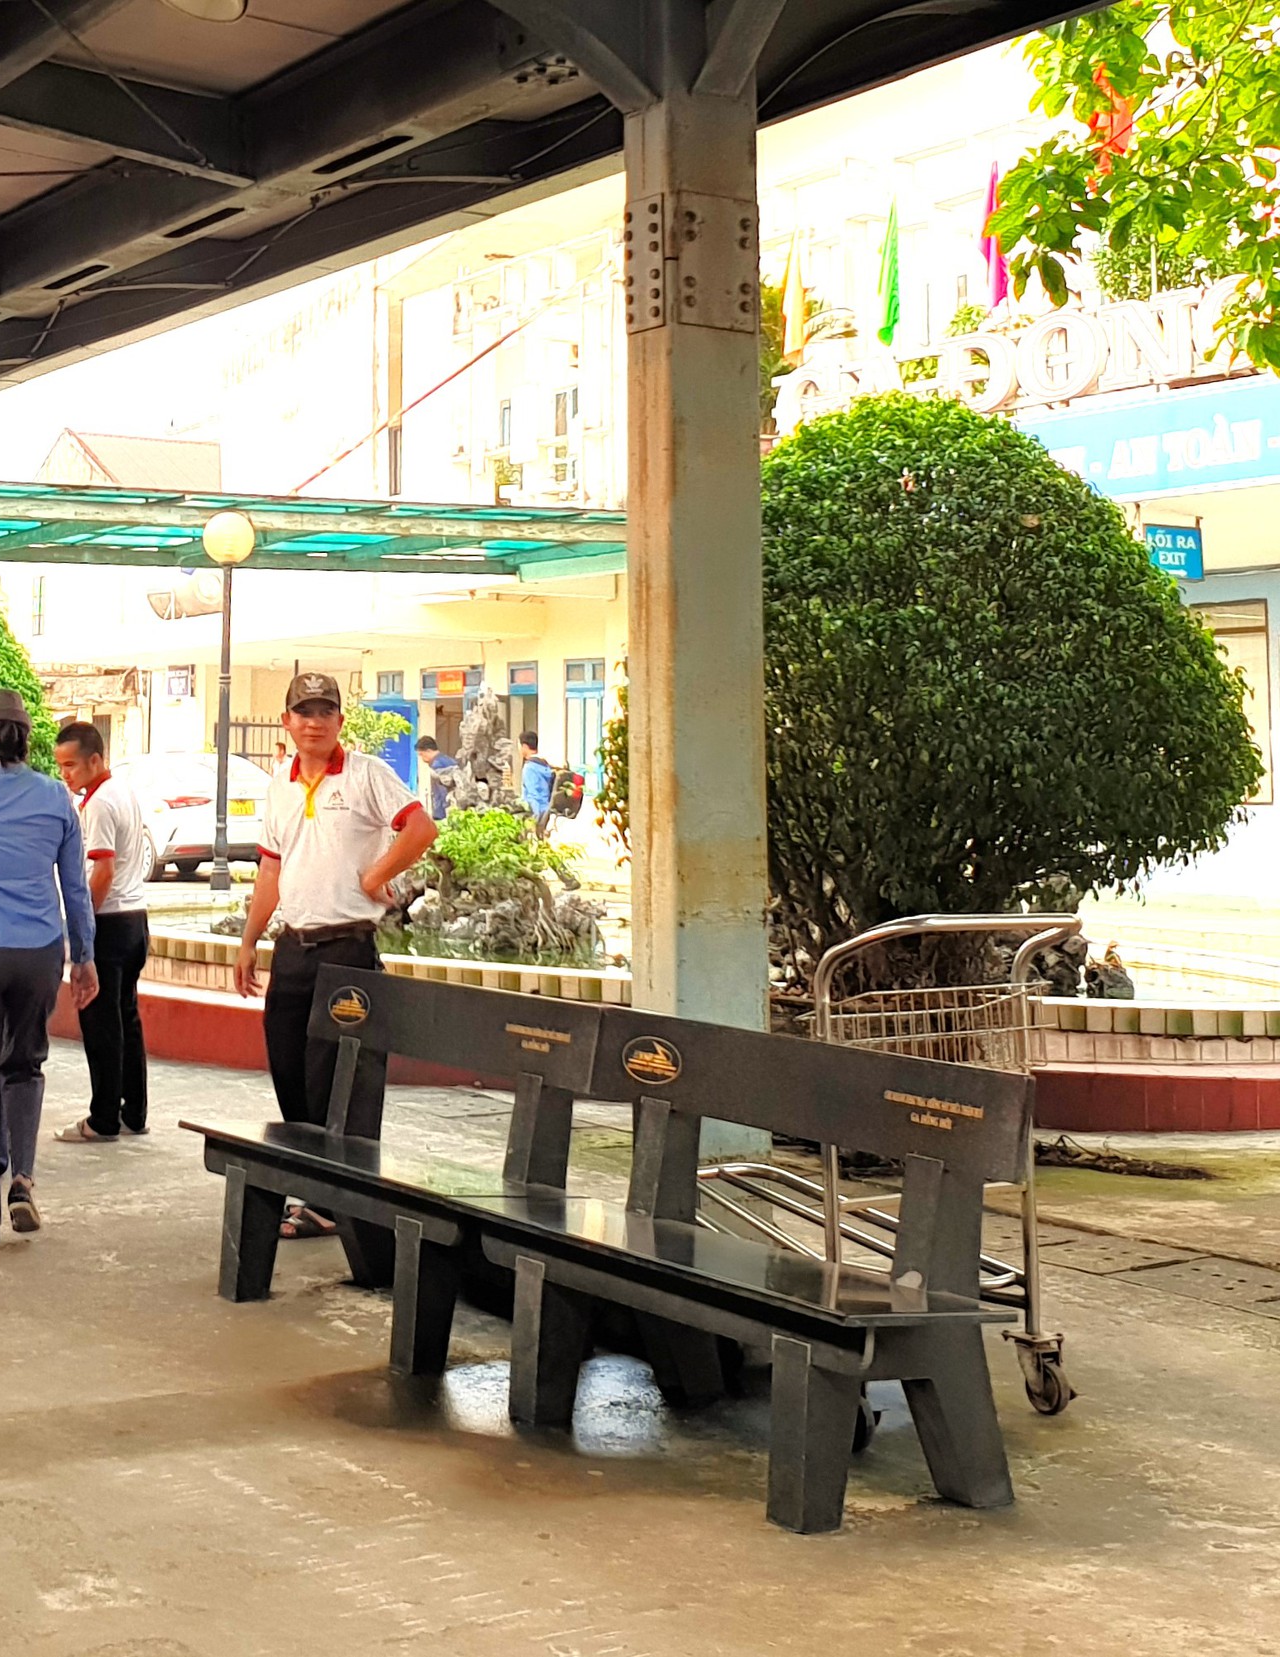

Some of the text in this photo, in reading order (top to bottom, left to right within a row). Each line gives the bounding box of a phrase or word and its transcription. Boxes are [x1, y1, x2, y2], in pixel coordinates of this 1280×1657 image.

[1106, 435, 1159, 480] AN
[1161, 412, 1262, 472] TOÀN
[1176, 535, 1197, 550] RA
[1158, 550, 1187, 566] EXIT
